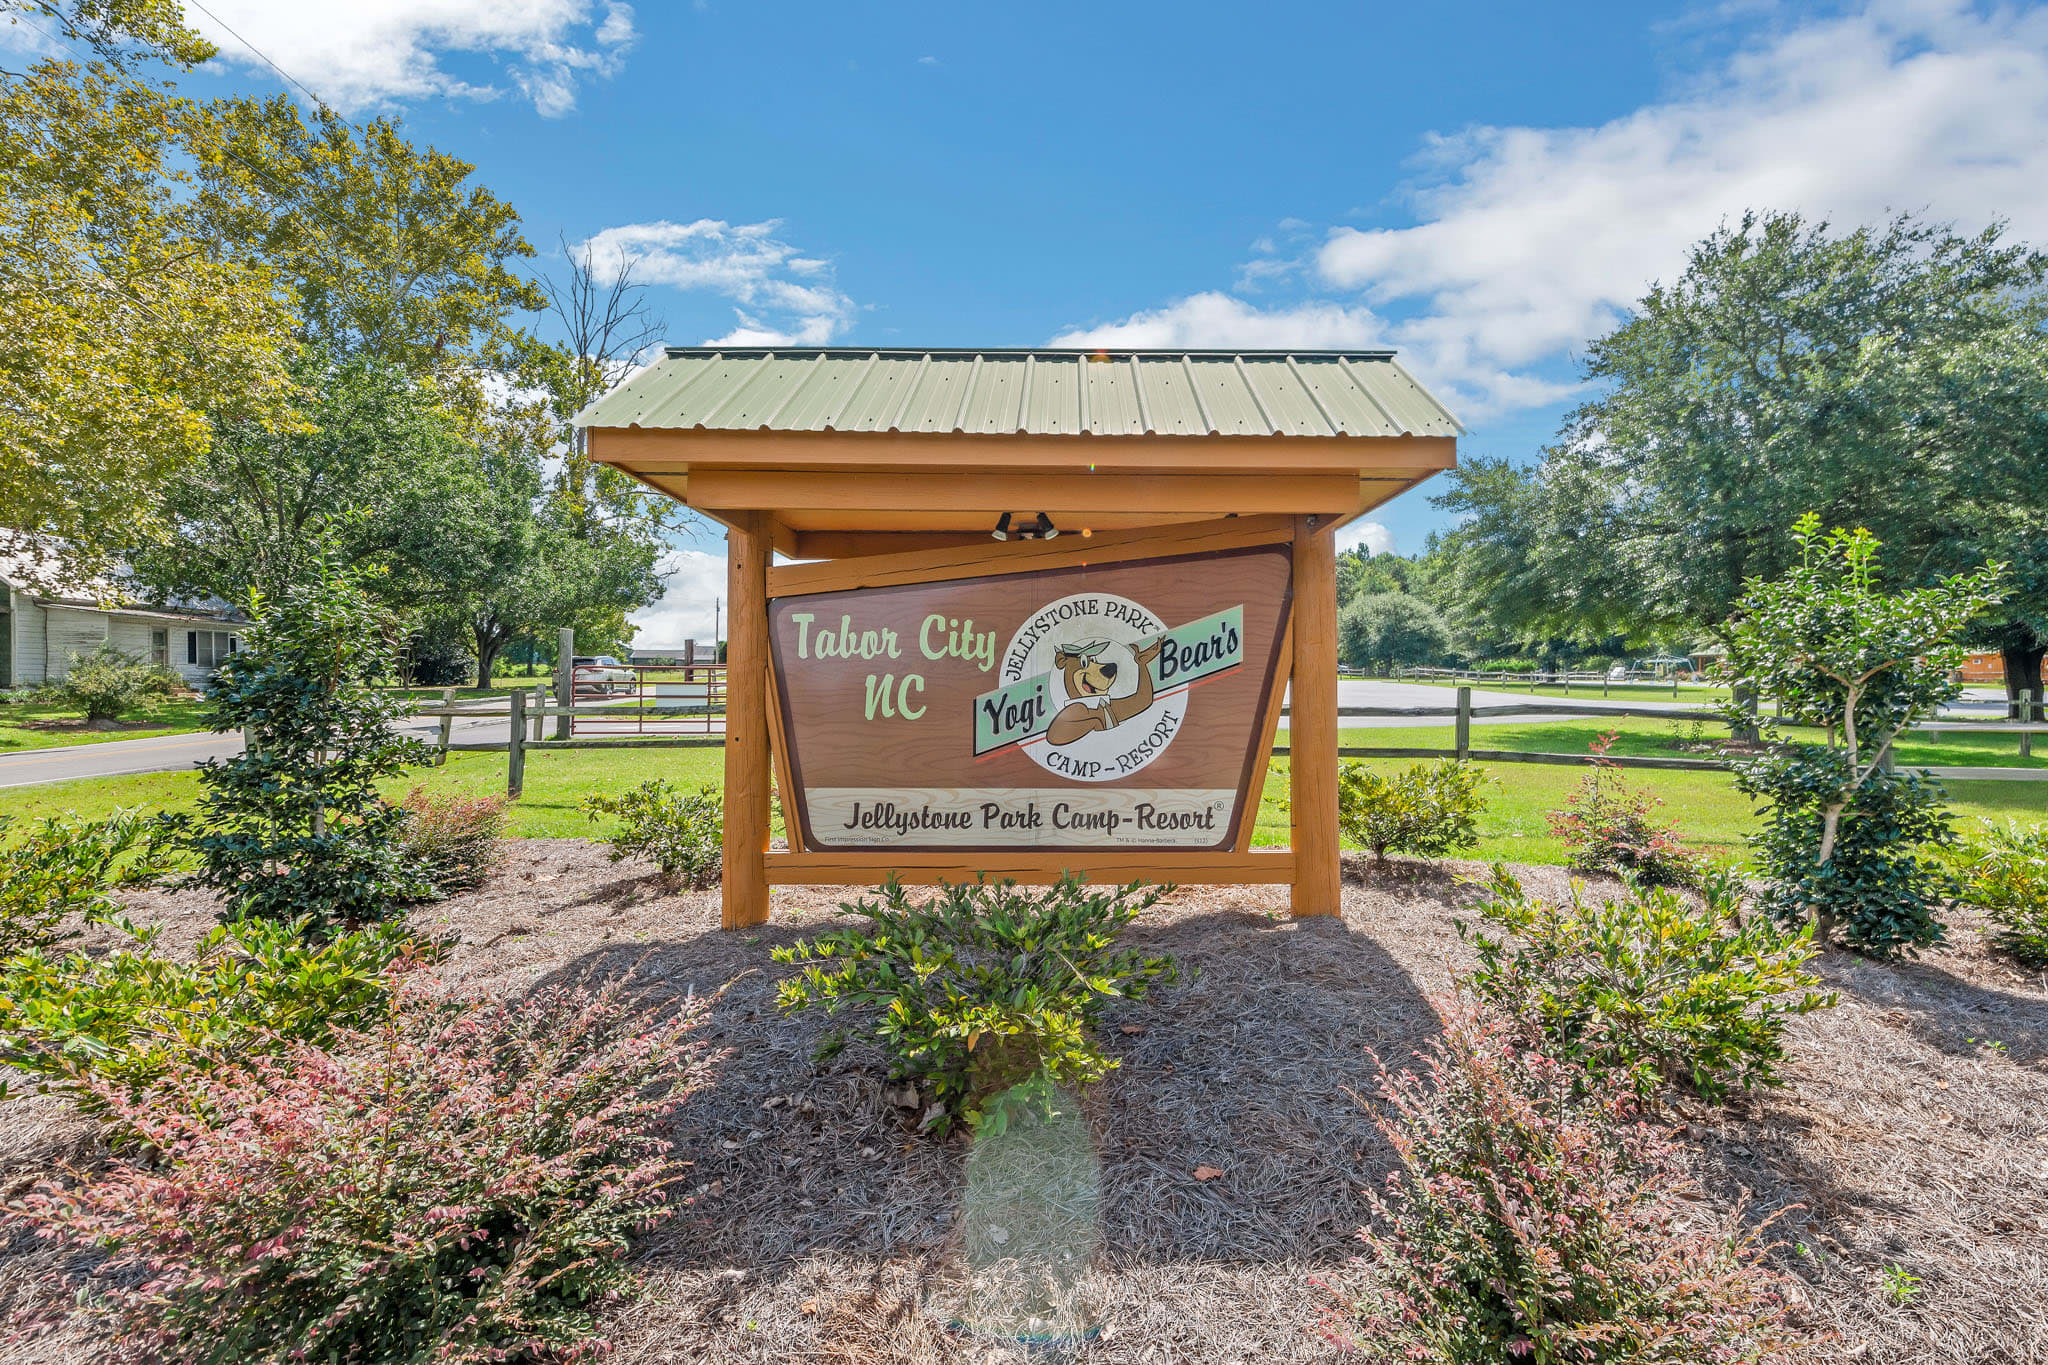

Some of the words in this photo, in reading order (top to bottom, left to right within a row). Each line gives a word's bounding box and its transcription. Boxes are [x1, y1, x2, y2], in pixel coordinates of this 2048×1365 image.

[792, 613, 902, 660] Tabor
[919, 614, 996, 672] City
[1006, 599, 1099, 682] JELLYSTONE
[864, 673, 927, 721] NC
[983, 685, 1046, 735] Yogi
[1159, 621, 1239, 681] Bear's
[843, 802, 973, 836] Jellystone
[980, 803, 1043, 830] Park
